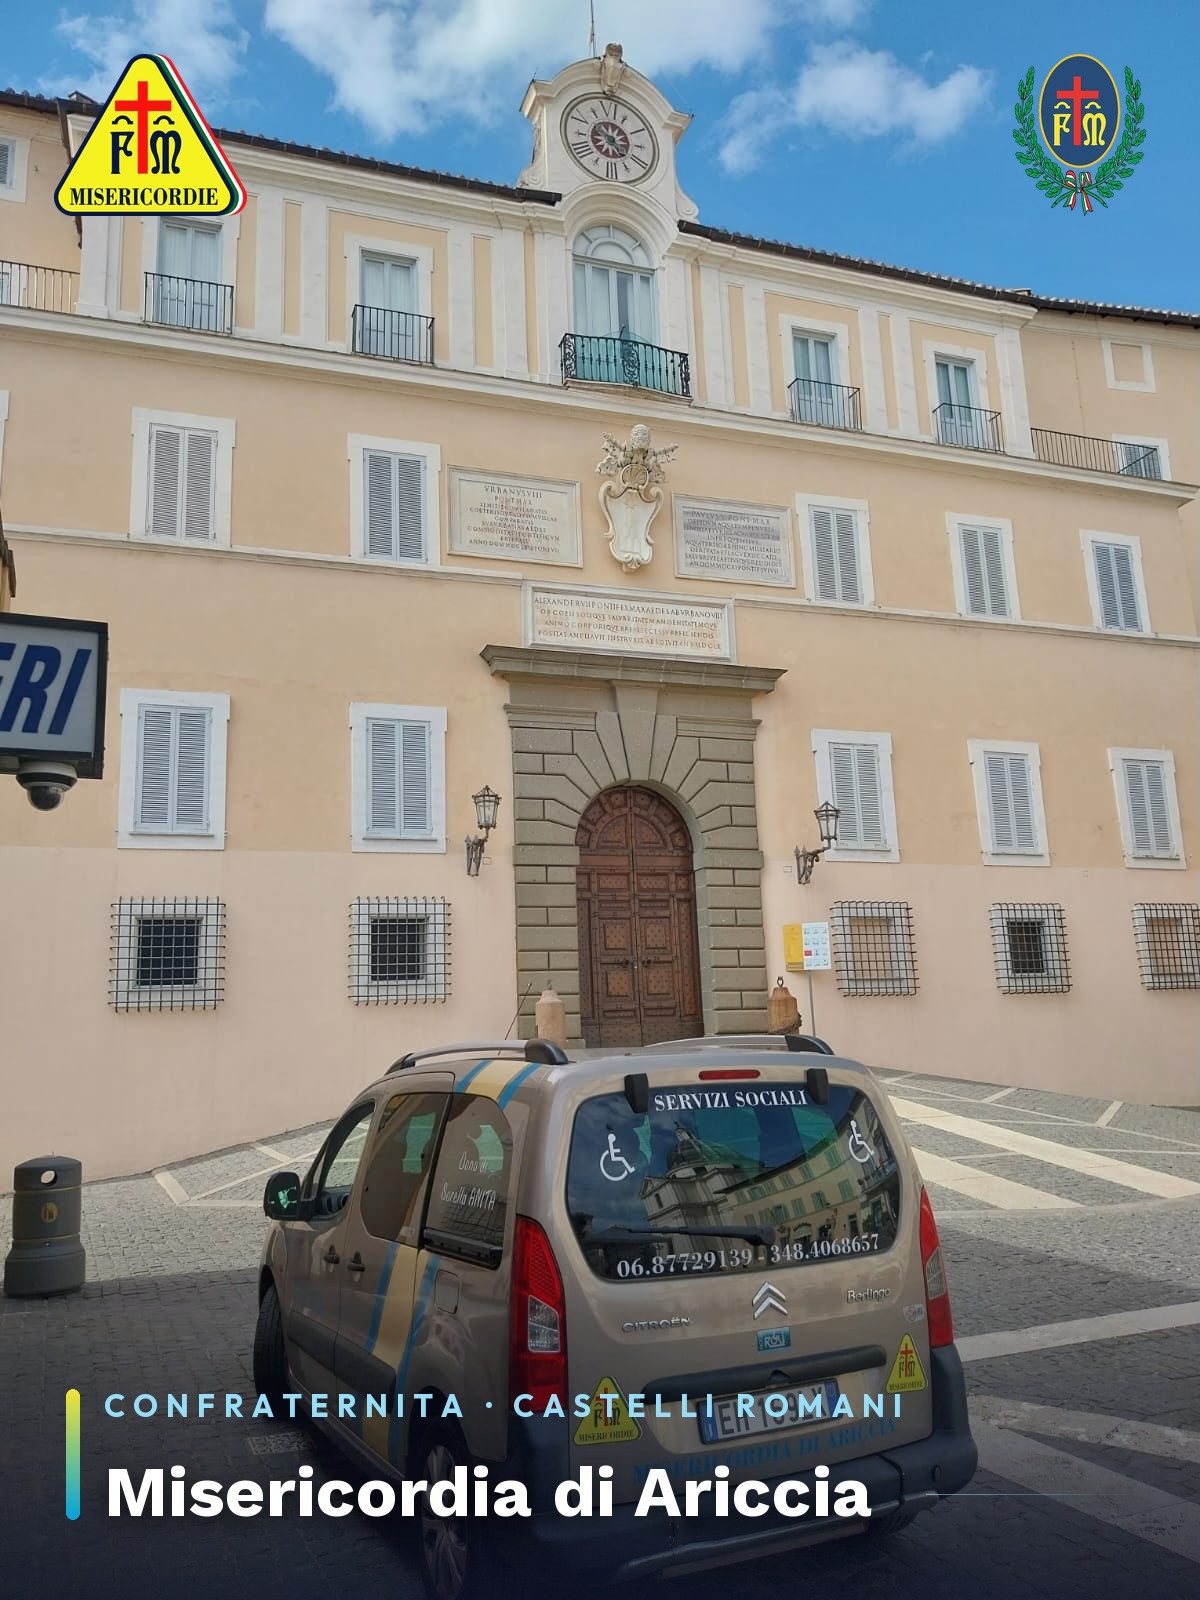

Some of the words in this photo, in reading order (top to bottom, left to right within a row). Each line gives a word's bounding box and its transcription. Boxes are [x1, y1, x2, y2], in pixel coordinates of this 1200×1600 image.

[654, 1091, 730, 1113] SERVIZI
[736, 1089, 809, 1107] SOCIALI
[616, 1247, 753, 1278] 06.87729139
[770, 1233, 880, 1263] 348.4068657
[847, 1287, 891, 1303] Berlingo
[578, 1429, 635, 1442] MISERICORDIE
